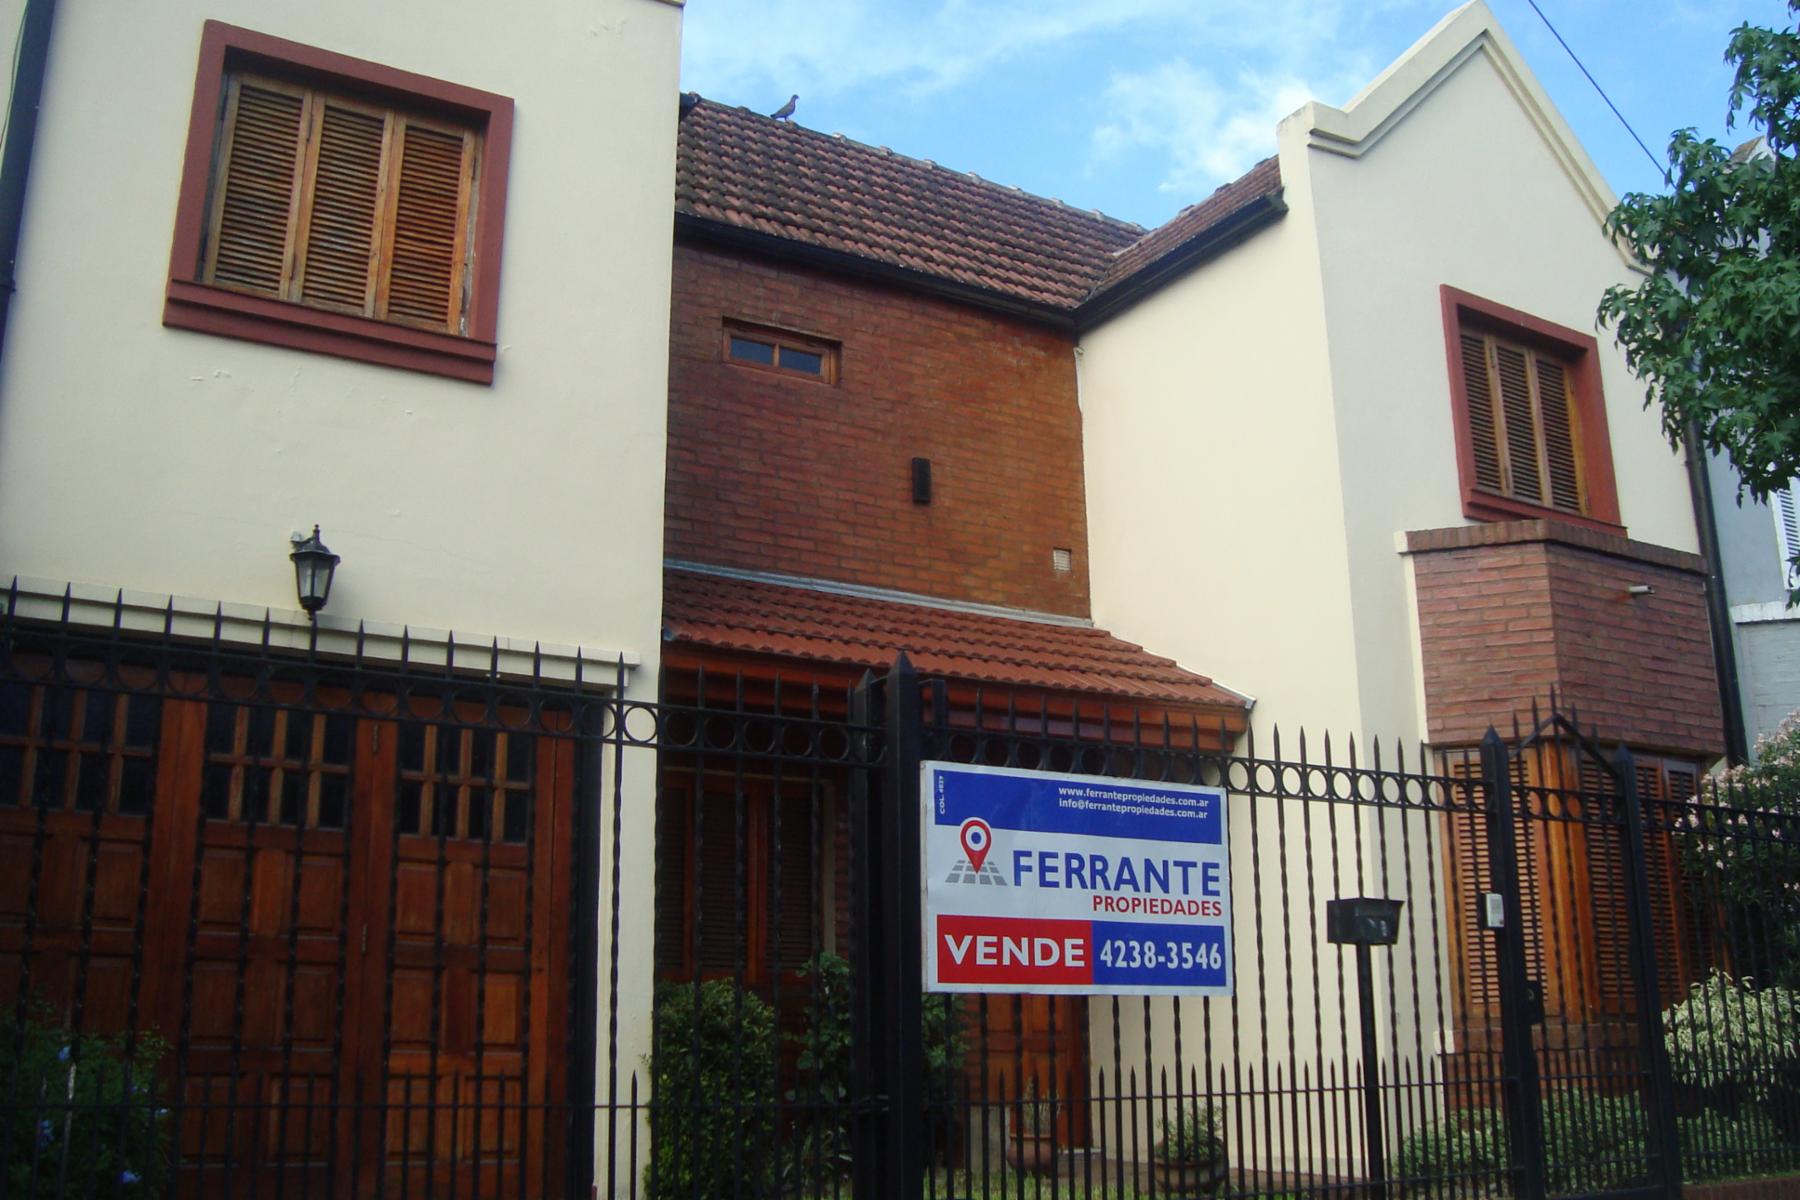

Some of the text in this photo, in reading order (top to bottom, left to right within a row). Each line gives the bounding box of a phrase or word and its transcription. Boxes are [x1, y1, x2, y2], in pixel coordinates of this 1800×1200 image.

[1058, 786, 1209, 807] www.ferrantepropiedades.com.ar
[1059, 797, 1208, 819] info@ferrantepropiedades.com.ar
[1013, 850, 1221, 897] FERRANTE
[1093, 895, 1222, 917] PROPIEDADES
[944, 934, 1085, 967] VENDE
[1099, 939, 1222, 970] 4238-3546
